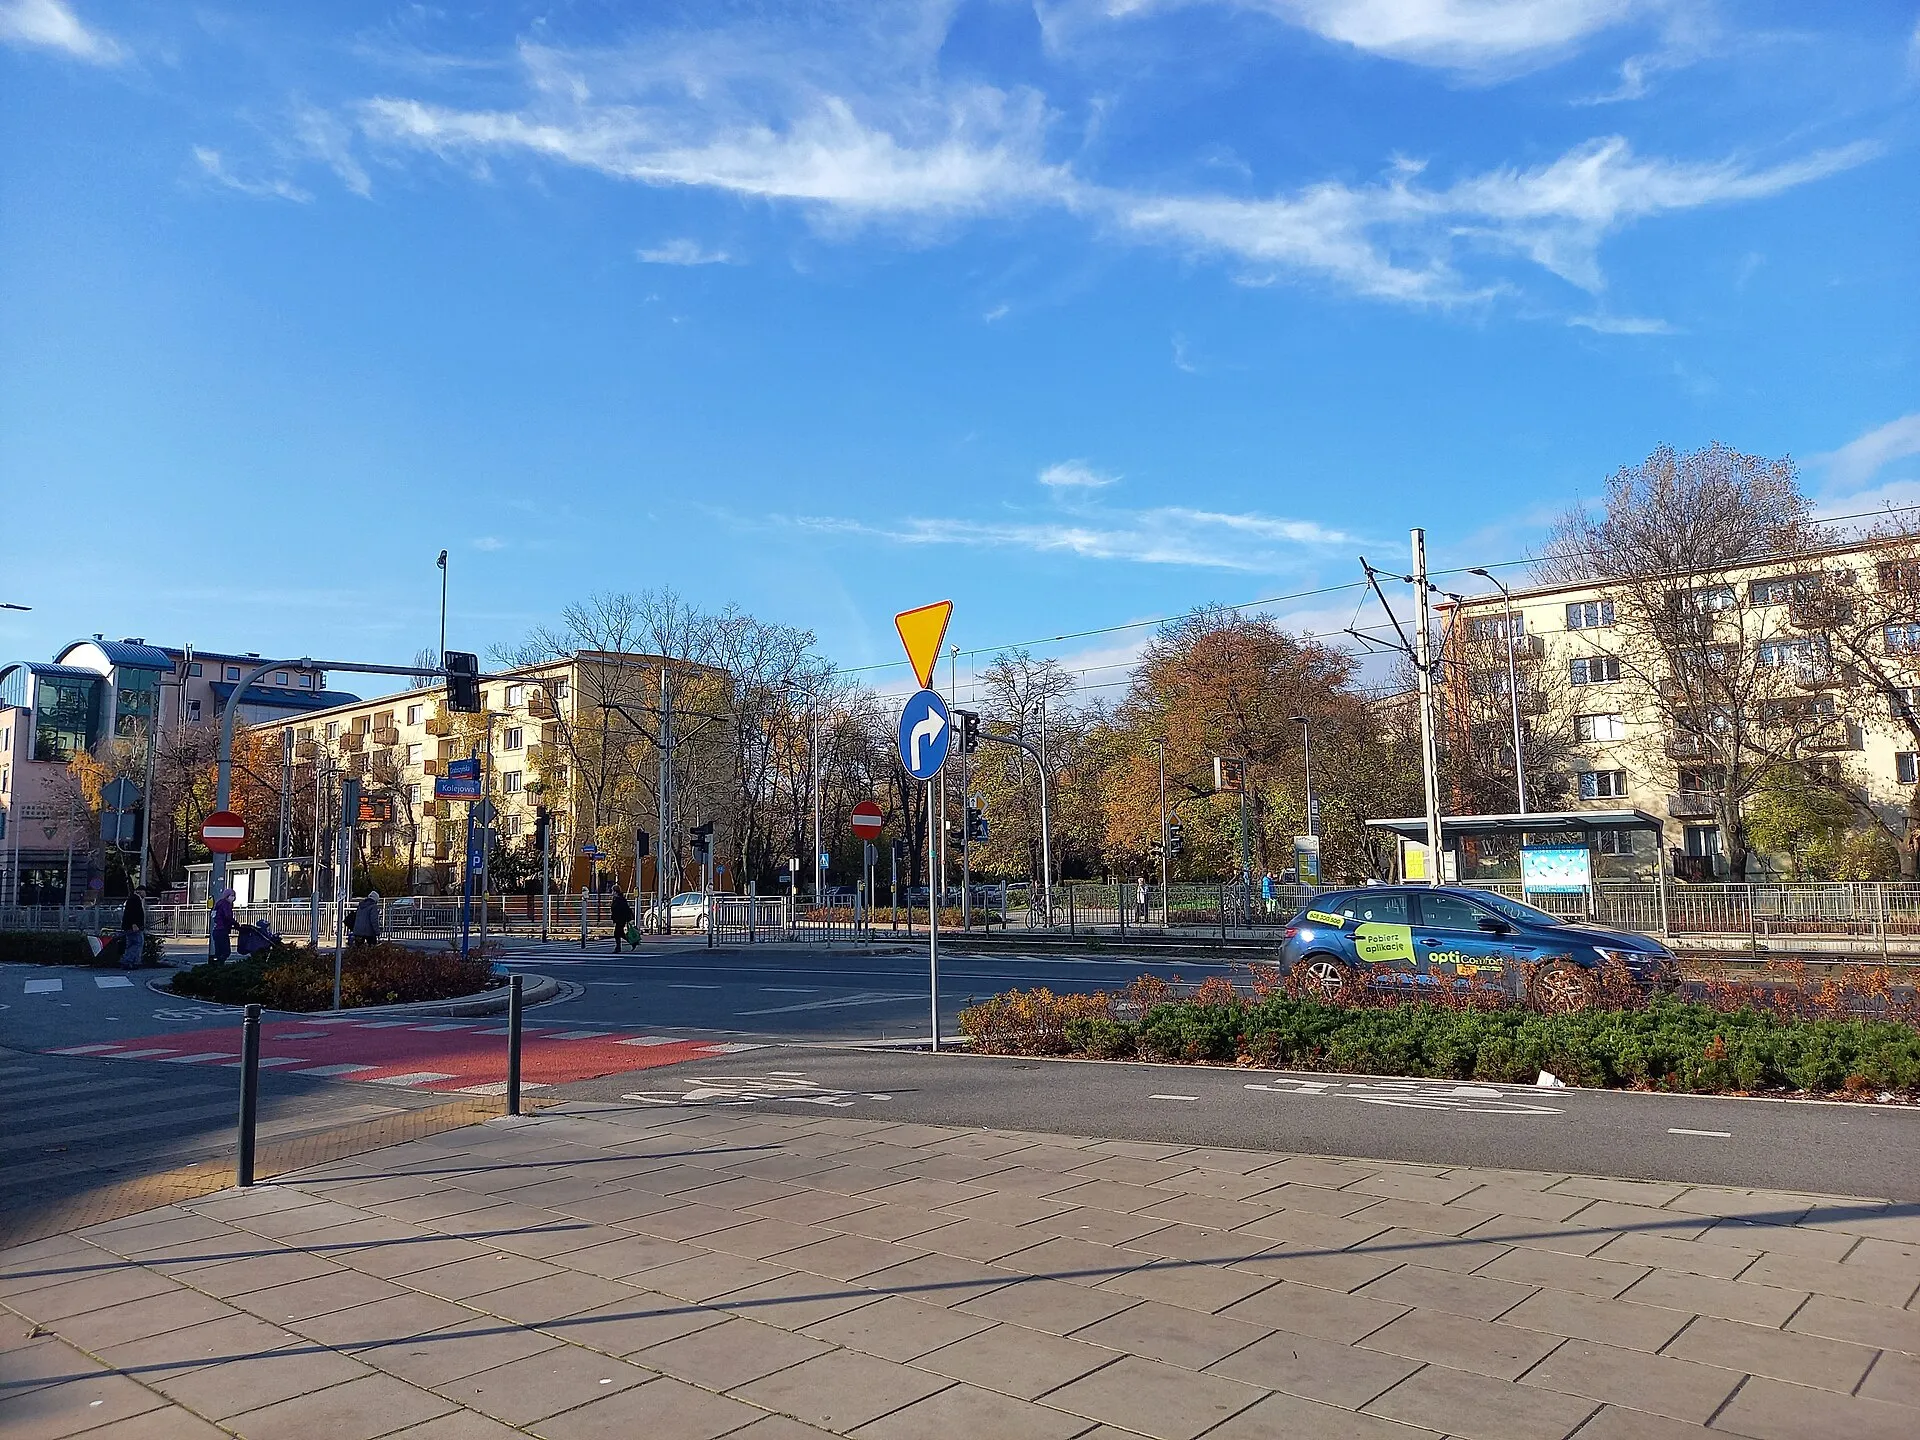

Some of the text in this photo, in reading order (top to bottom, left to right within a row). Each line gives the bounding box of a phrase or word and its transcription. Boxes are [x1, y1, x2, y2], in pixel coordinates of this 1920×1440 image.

[442, 784, 475, 794] Kolejowa
[1367, 934, 1400, 943] Pobierz
[1365, 942, 1404, 954] aplikację
